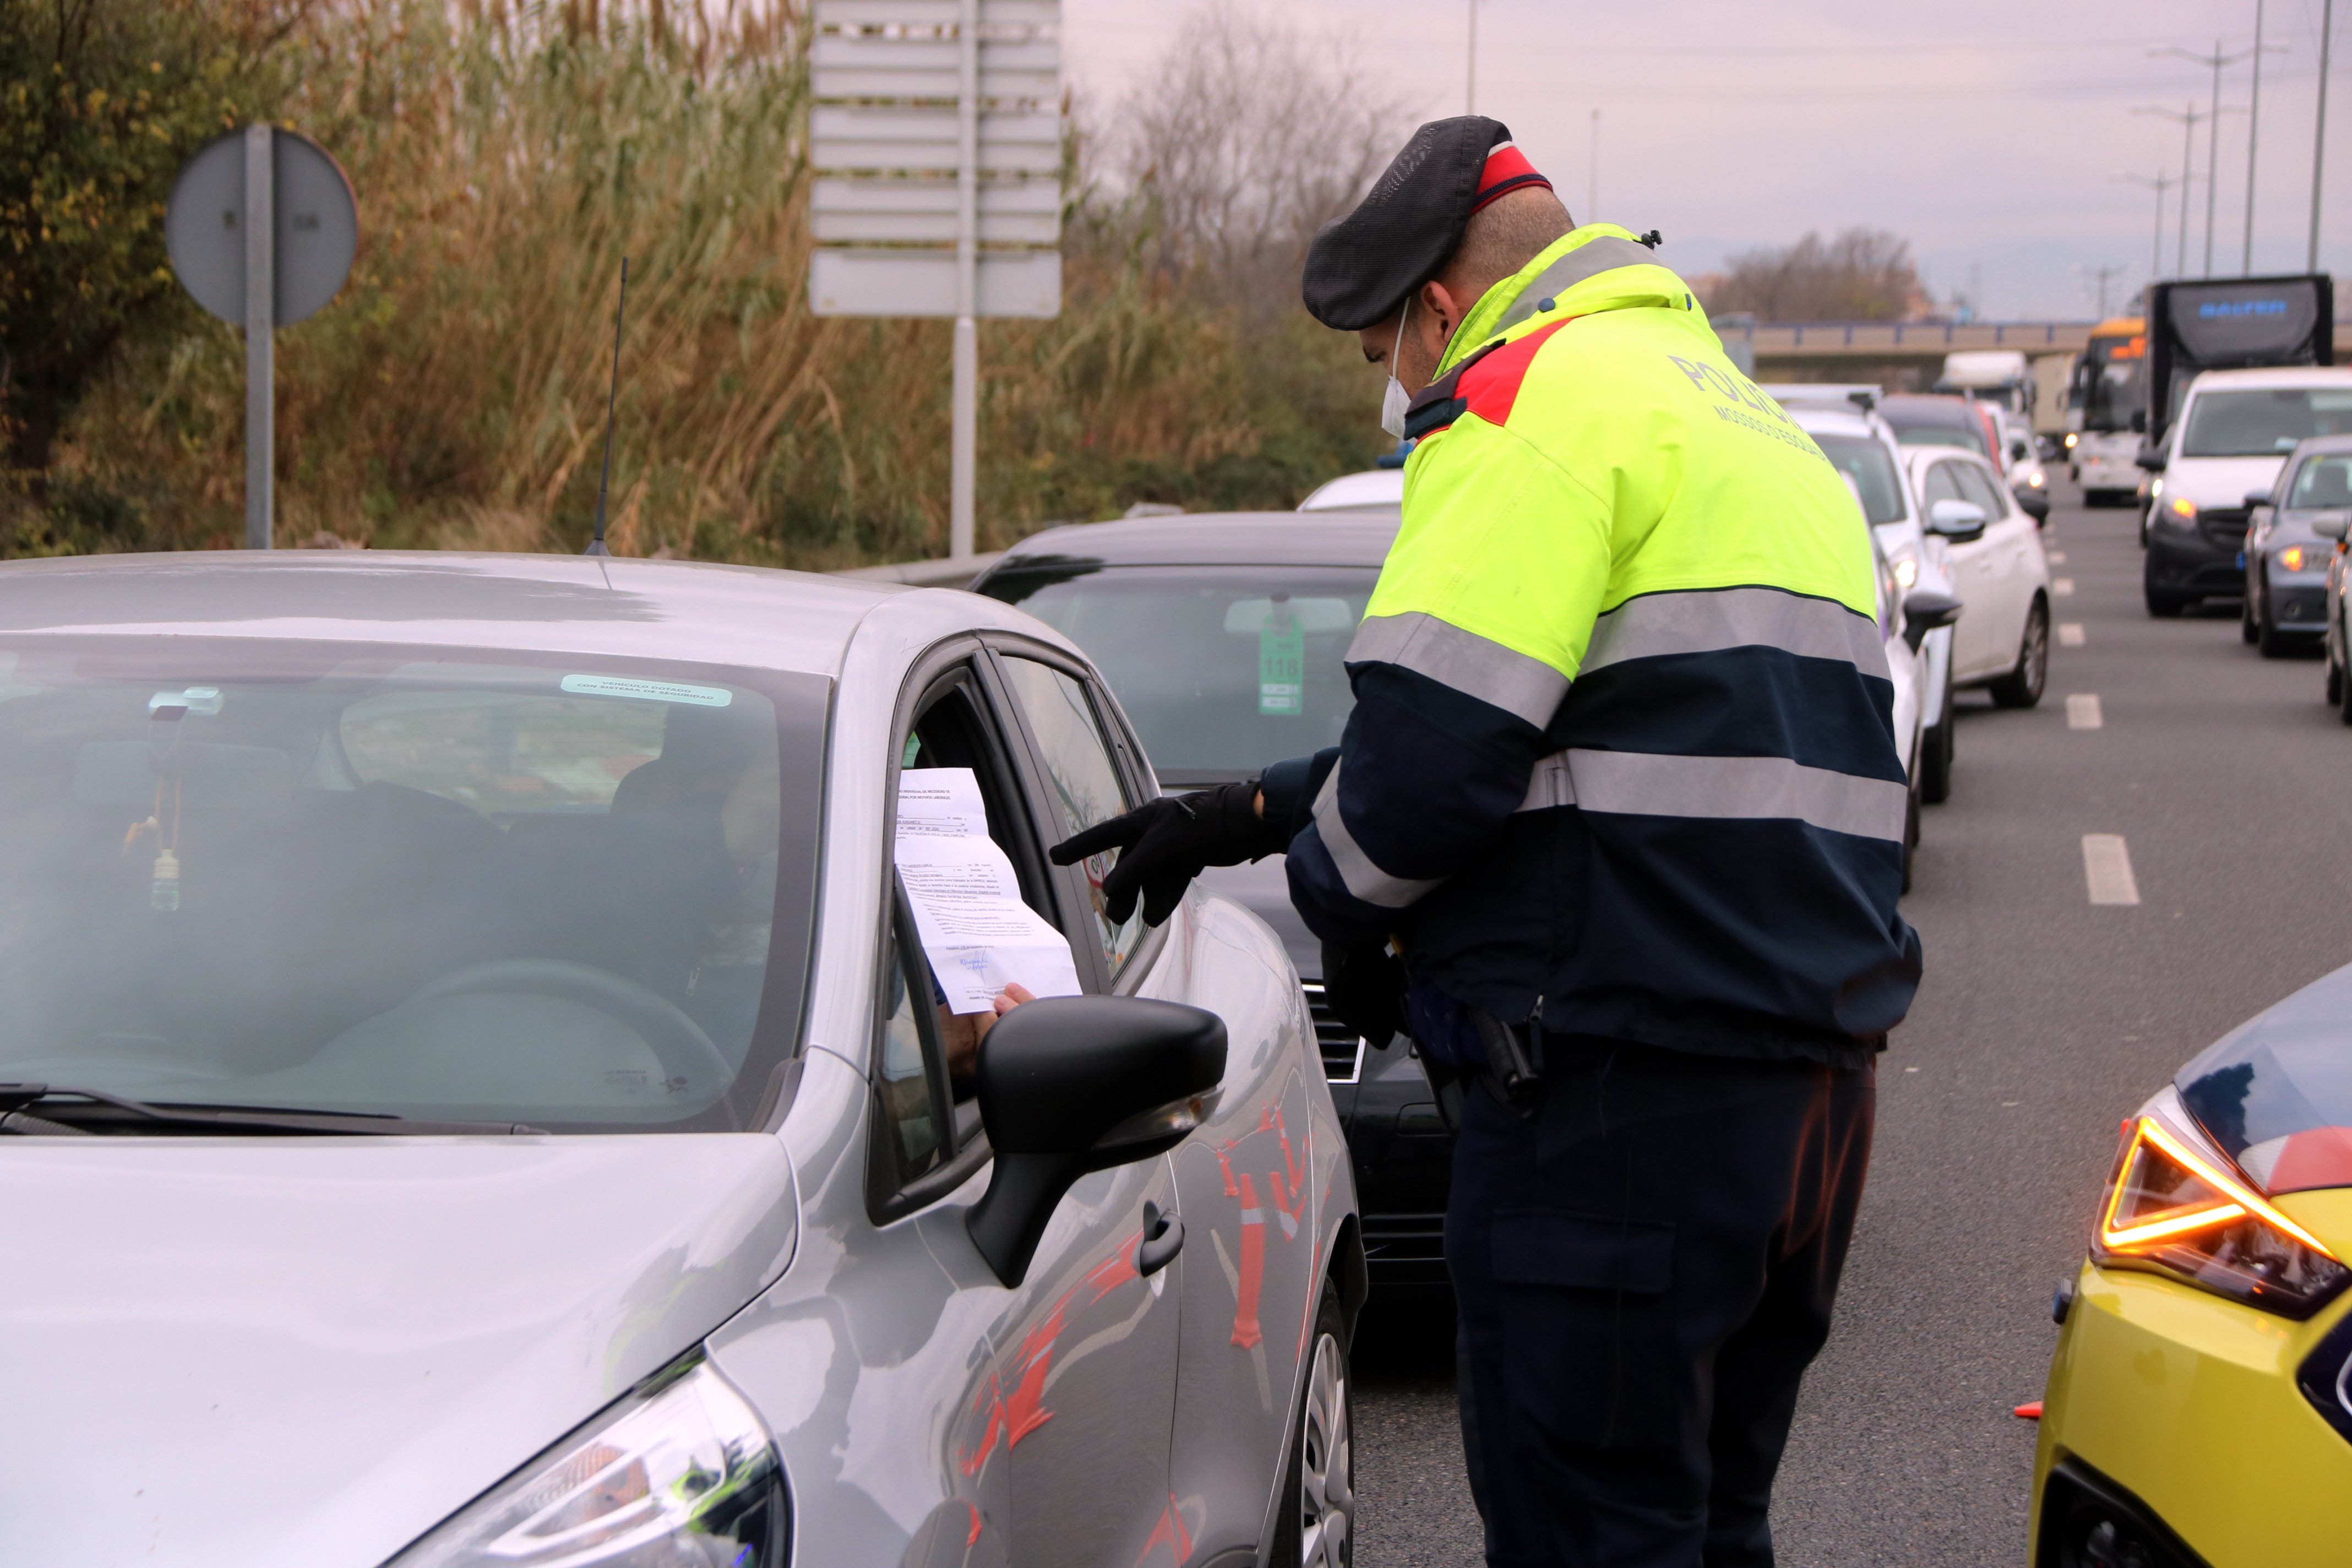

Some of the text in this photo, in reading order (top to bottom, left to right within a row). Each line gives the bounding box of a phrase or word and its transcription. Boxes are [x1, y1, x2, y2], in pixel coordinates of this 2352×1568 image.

[1713, 405, 1770, 435] MOSSOS
[651, 685, 692, 694] DOTADO
[658, 690, 714, 700] SEGURIDAD
